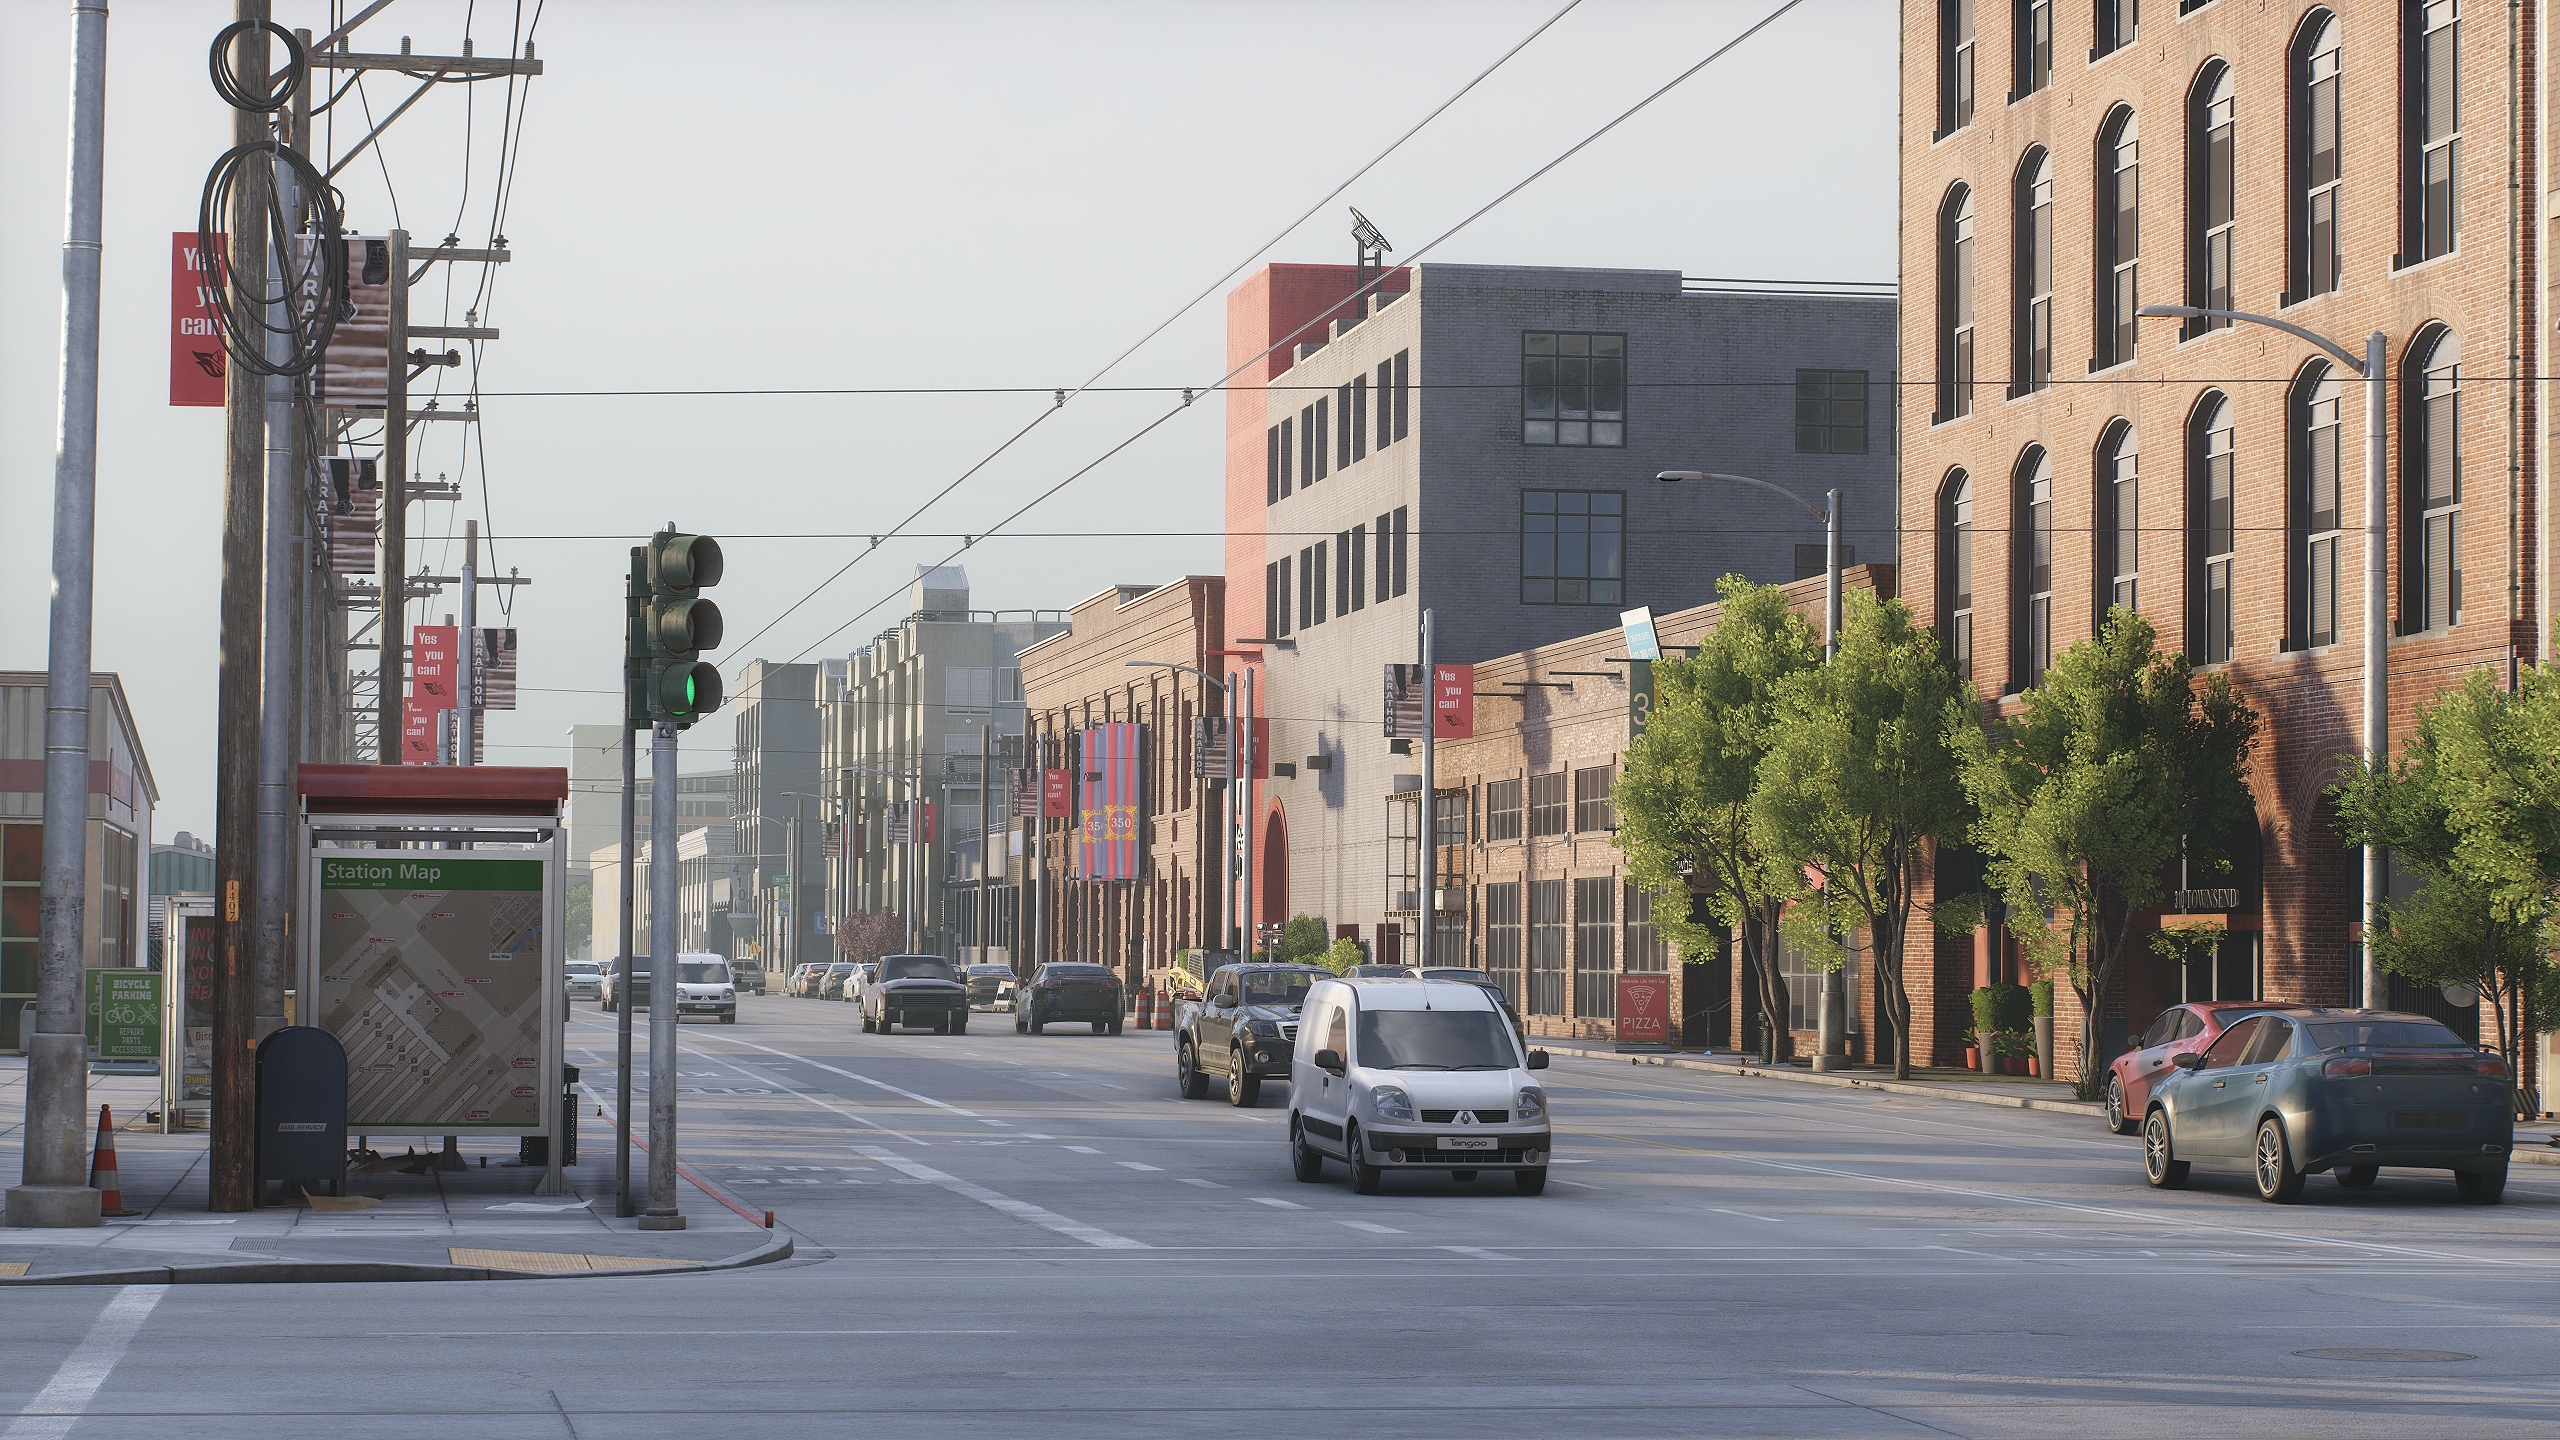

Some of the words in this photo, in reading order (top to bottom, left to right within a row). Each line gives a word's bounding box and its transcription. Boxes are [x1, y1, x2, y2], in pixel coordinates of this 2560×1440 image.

[418, 632, 437, 645] Yes
[424, 650, 444, 662] you
[417, 664, 441, 676] can!
[474, 628, 483, 705] MARATHON
[1440, 671, 1456, 681] Yes
[1445, 687, 1462, 697] you
[1386, 666, 1394, 733] MARATHON
[1439, 699, 1459, 709] can!
[412, 716, 428, 726] you
[406, 726, 425, 736] can!
[1087, 821, 1103, 831] 35
[1111, 818, 1131, 828] 350
[327, 863, 392, 879] Station
[400, 864, 441, 883] Map
[733, 864, 746, 900] 410
[2186, 889, 2237, 909] TOWNSEND
[113, 979, 151, 989] BICYCLE
[112, 990, 152, 1000] PARKING
[1623, 1017, 1661, 1029] PIZZA
[119, 1028, 144, 1036] REPAIRS
[122, 1036, 141, 1045] PARTS
[111, 1045, 152, 1054] ACCESSORIES
[1449, 1138, 1487, 1149] Tangoo
